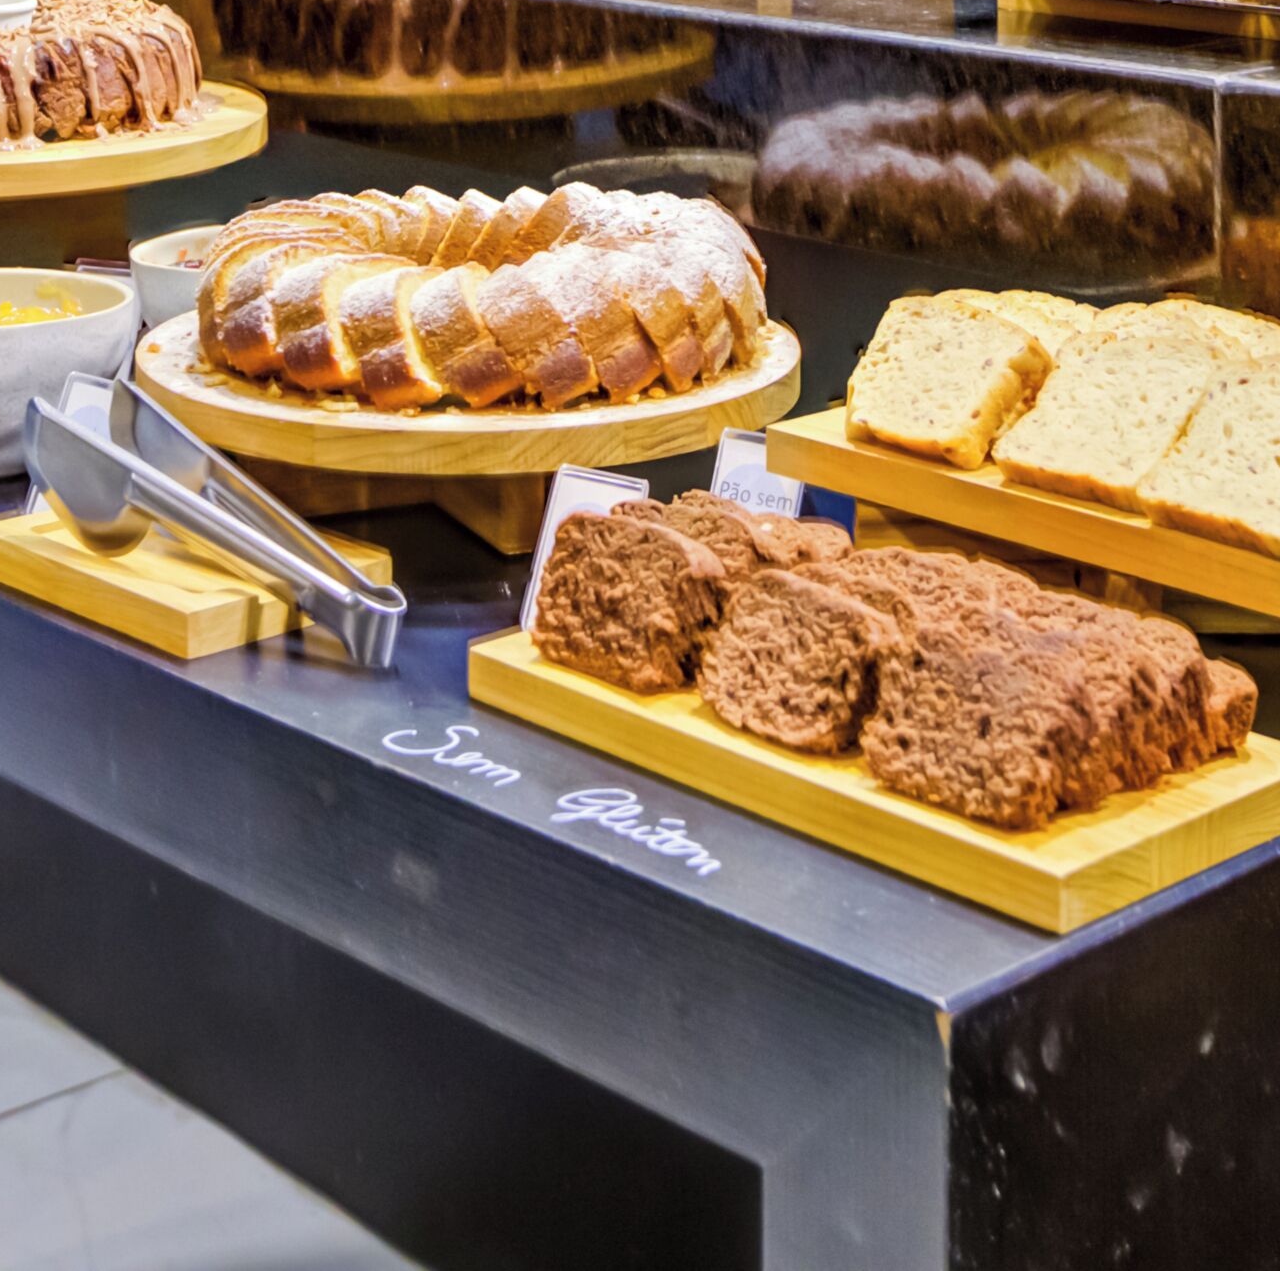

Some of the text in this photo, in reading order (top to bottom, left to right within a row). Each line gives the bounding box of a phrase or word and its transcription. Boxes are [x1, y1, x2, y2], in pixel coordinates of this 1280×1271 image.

[720, 480, 793, 512] Pão sem
[382, 725, 521, 787] Sem
